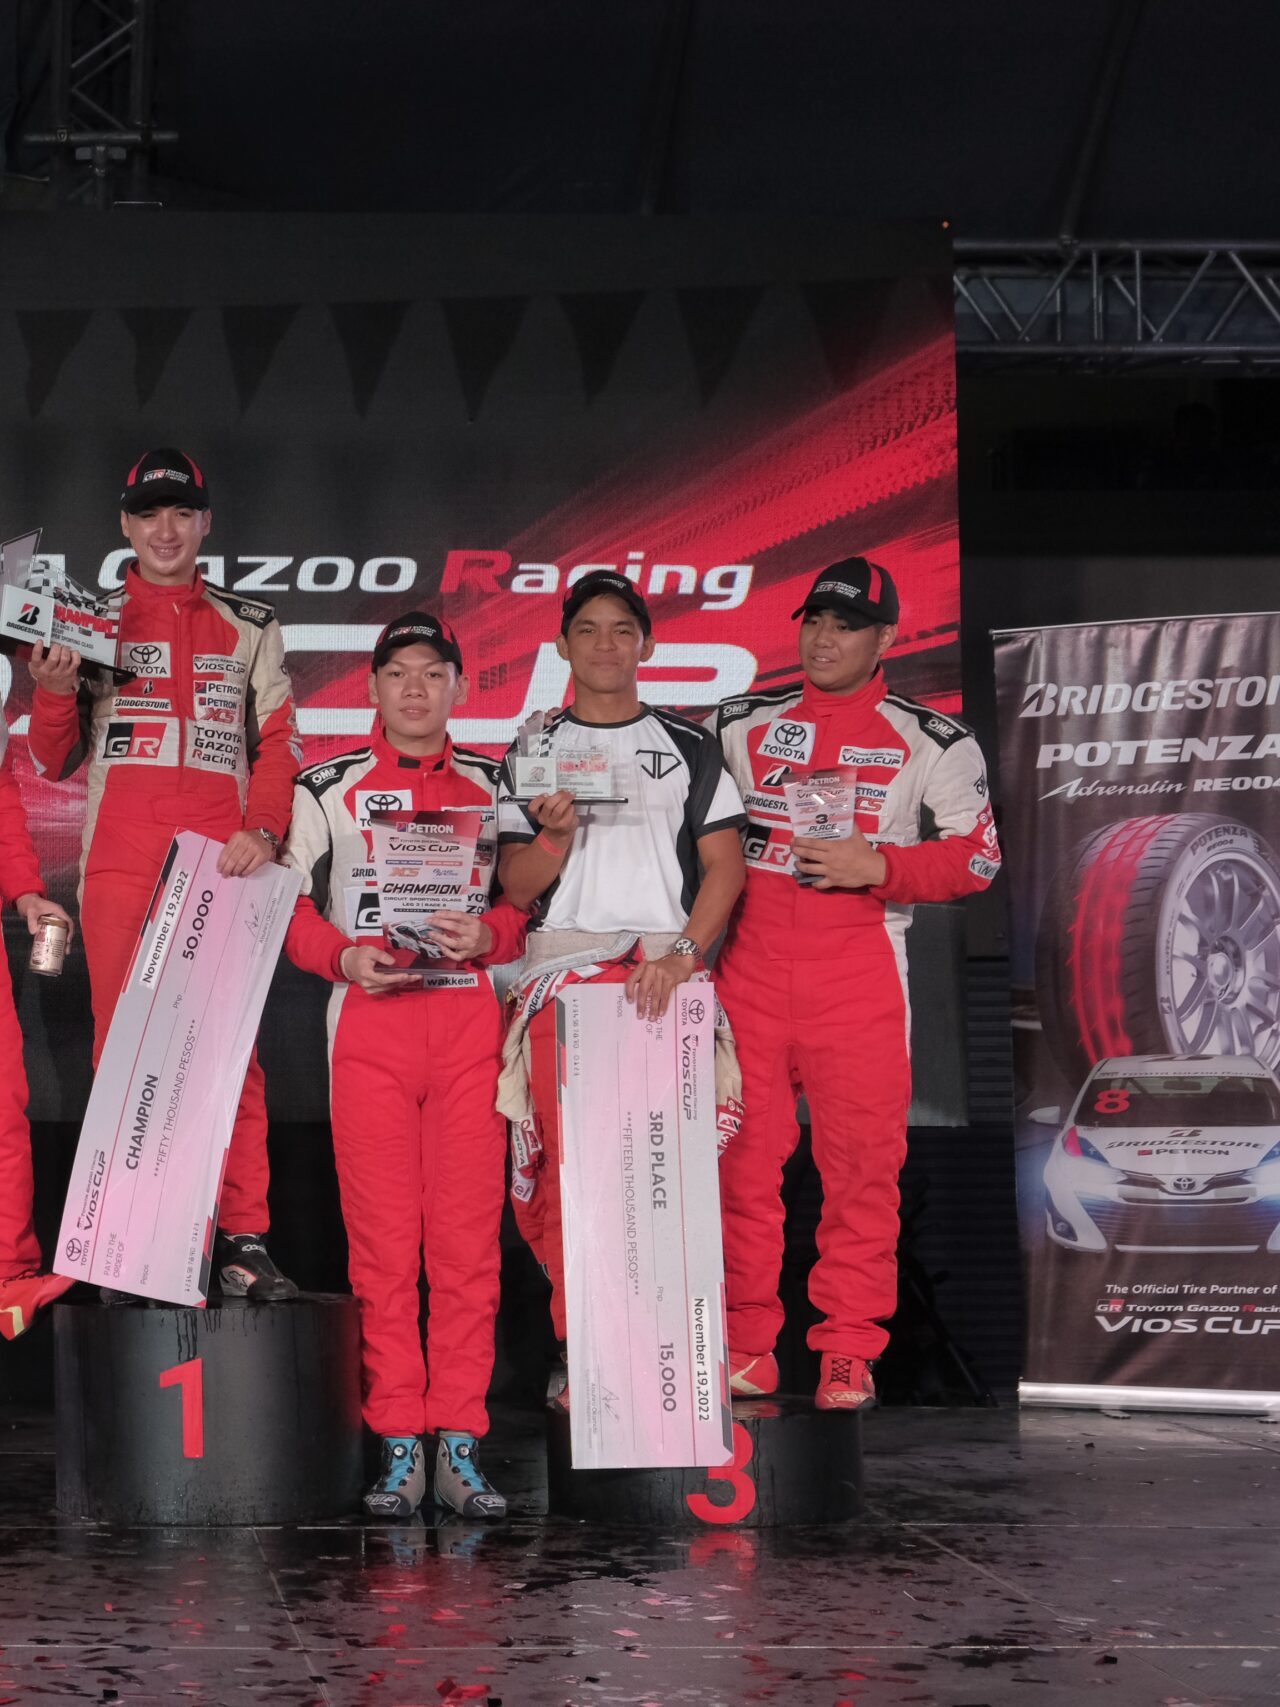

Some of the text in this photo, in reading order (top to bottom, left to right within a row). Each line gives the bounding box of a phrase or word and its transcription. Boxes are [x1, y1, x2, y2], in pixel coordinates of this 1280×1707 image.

[239, 606, 266, 620] OMP
[6, 621, 46, 638] BRIDGESTONE
[124, 666, 167, 675] TOYOTA
[208, 683, 241, 696] PETRON
[114, 698, 170, 709] BRIDGESTONE
[207, 697, 237, 709] PETRON
[723, 703, 749, 715] OMP
[200, 707, 236, 724] XCS
[194, 726, 242, 744] TOYOTA
[928, 718, 954, 736] OMP
[106, 736, 160, 758] GR
[194, 738, 239, 755] GAZOO
[763, 744, 805, 761] TOYOTA
[1036, 733, 1280, 769] POTENZA
[192, 749, 237, 770] Racing
[842, 755, 901, 766] VIOS CUP
[311, 766, 338, 784] OMP
[854, 787, 887, 798] ETRON
[1038, 775, 1280, 801] Adrenalin RE00
[408, 823, 454, 834] PETRON
[389, 843, 460, 853] VIOS CUP
[1190, 826, 1248, 856] POTENZA
[382, 883, 462, 895] CHAMPION
[142, 871, 189, 983] November 19,2022
[182, 889, 214, 961] 50,000
[427, 975, 476, 987] wakkeen
[682, 1034, 692, 1121] VIOS CUP
[164, 1071, 185, 1131] THOUSAND
[1094, 1089, 1130, 1114] 8
[126, 1074, 159, 1170] CHAMPION
[1105, 1140, 1266, 1149] BRIDGESTONE
[1156, 1148, 1230, 1156] PETRON
[650, 1111, 667, 1210] 3RD PLACE
[84, 1151, 106, 1231] VIOS CUP
[624, 1175, 637, 1239] THOUSAND
[81, 1240, 90, 1266] TOYOTA
[1106, 1284, 1278, 1294] The Official Tire Partner of
[1126, 1304, 1183, 1312] TOYOTA
[1187, 1304, 1240, 1312] GAZOO
[1095, 1315, 1198, 1334] VIOS
[694, 1298, 710, 1421] November 19,2022
[660, 1342, 677, 1413] 15,000
[160, 1358, 203, 1458] 1
[686, 1420, 756, 1525] 3
